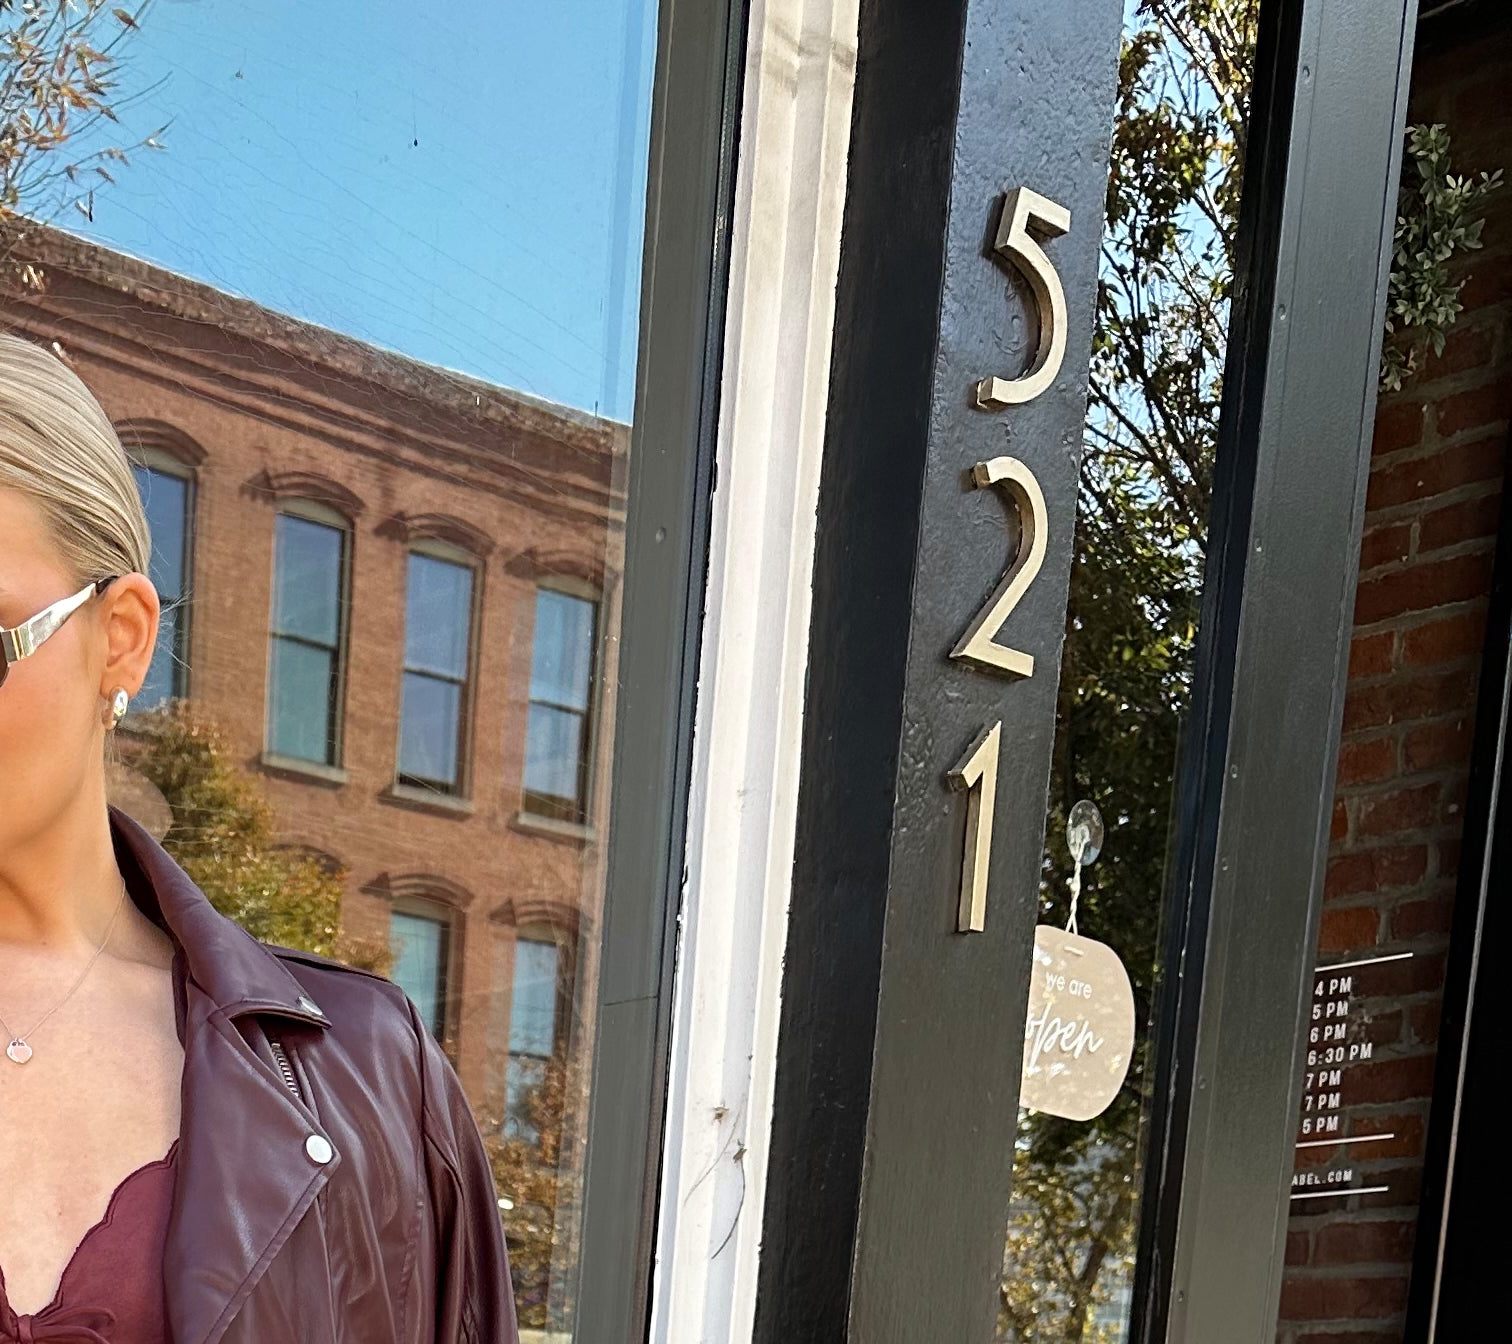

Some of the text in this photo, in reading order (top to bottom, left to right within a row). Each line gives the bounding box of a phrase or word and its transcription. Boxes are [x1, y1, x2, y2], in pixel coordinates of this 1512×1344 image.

[947, 185, 1071, 933] 521
[1045, 971, 1093, 999] we are
[1315, 976, 1352, 996] 4 PM
[1312, 1000, 1348, 1020] 5 PM
[1025, 1002, 1104, 1074] open
[1310, 1023, 1347, 1042] 6 PM
[1308, 1042, 1372, 1066] 6:30 PM
[1306, 1069, 1341, 1089] 7 PM
[1305, 1092, 1341, 1111] 7 PM
[1302, 1115, 1339, 1134] 5 PM
